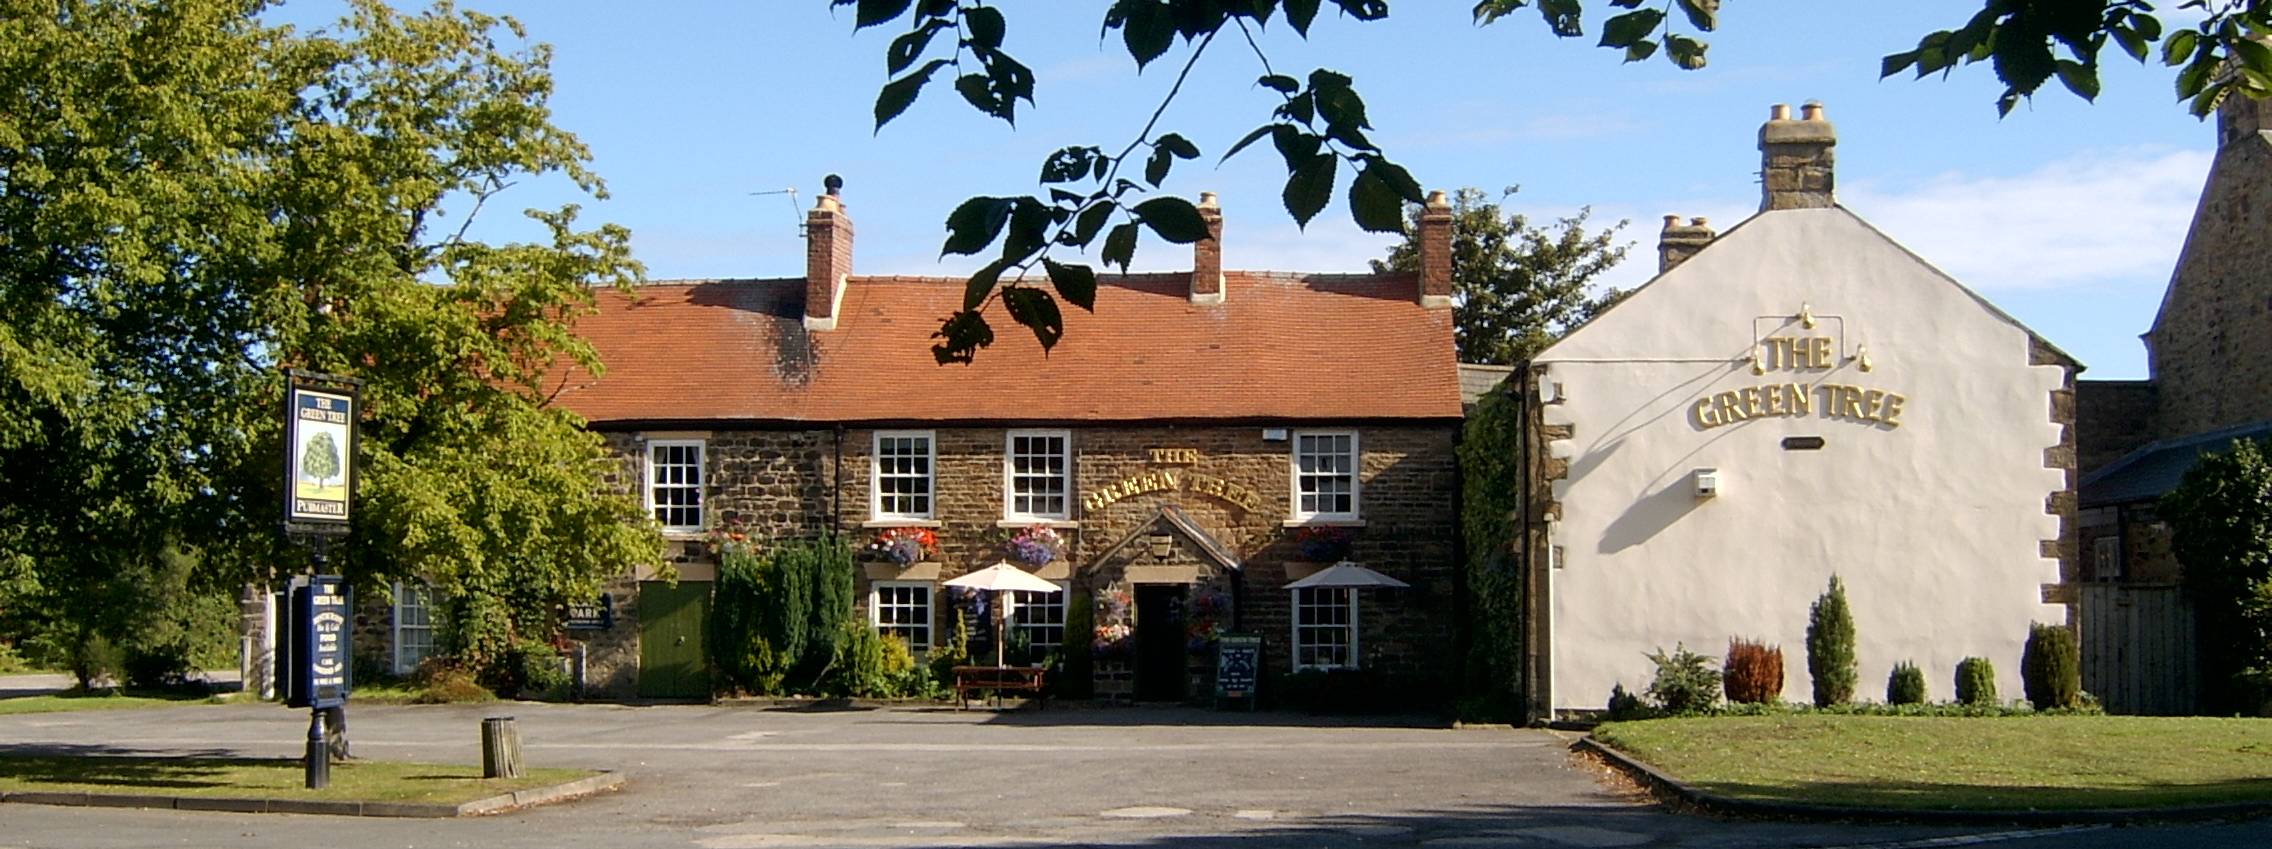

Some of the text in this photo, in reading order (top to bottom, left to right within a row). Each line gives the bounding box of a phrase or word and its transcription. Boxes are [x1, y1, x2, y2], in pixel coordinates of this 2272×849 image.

[1767, 337, 1833, 369] THE
[315, 397, 332, 410] THE
[1697, 382, 1905, 427] GREEN TREE
[300, 407, 346, 424] GREEN TREE
[1149, 448, 1198, 463] THE
[1084, 470, 1261, 512] GREEN TREE
[296, 500, 344, 514] PUBMASTER
